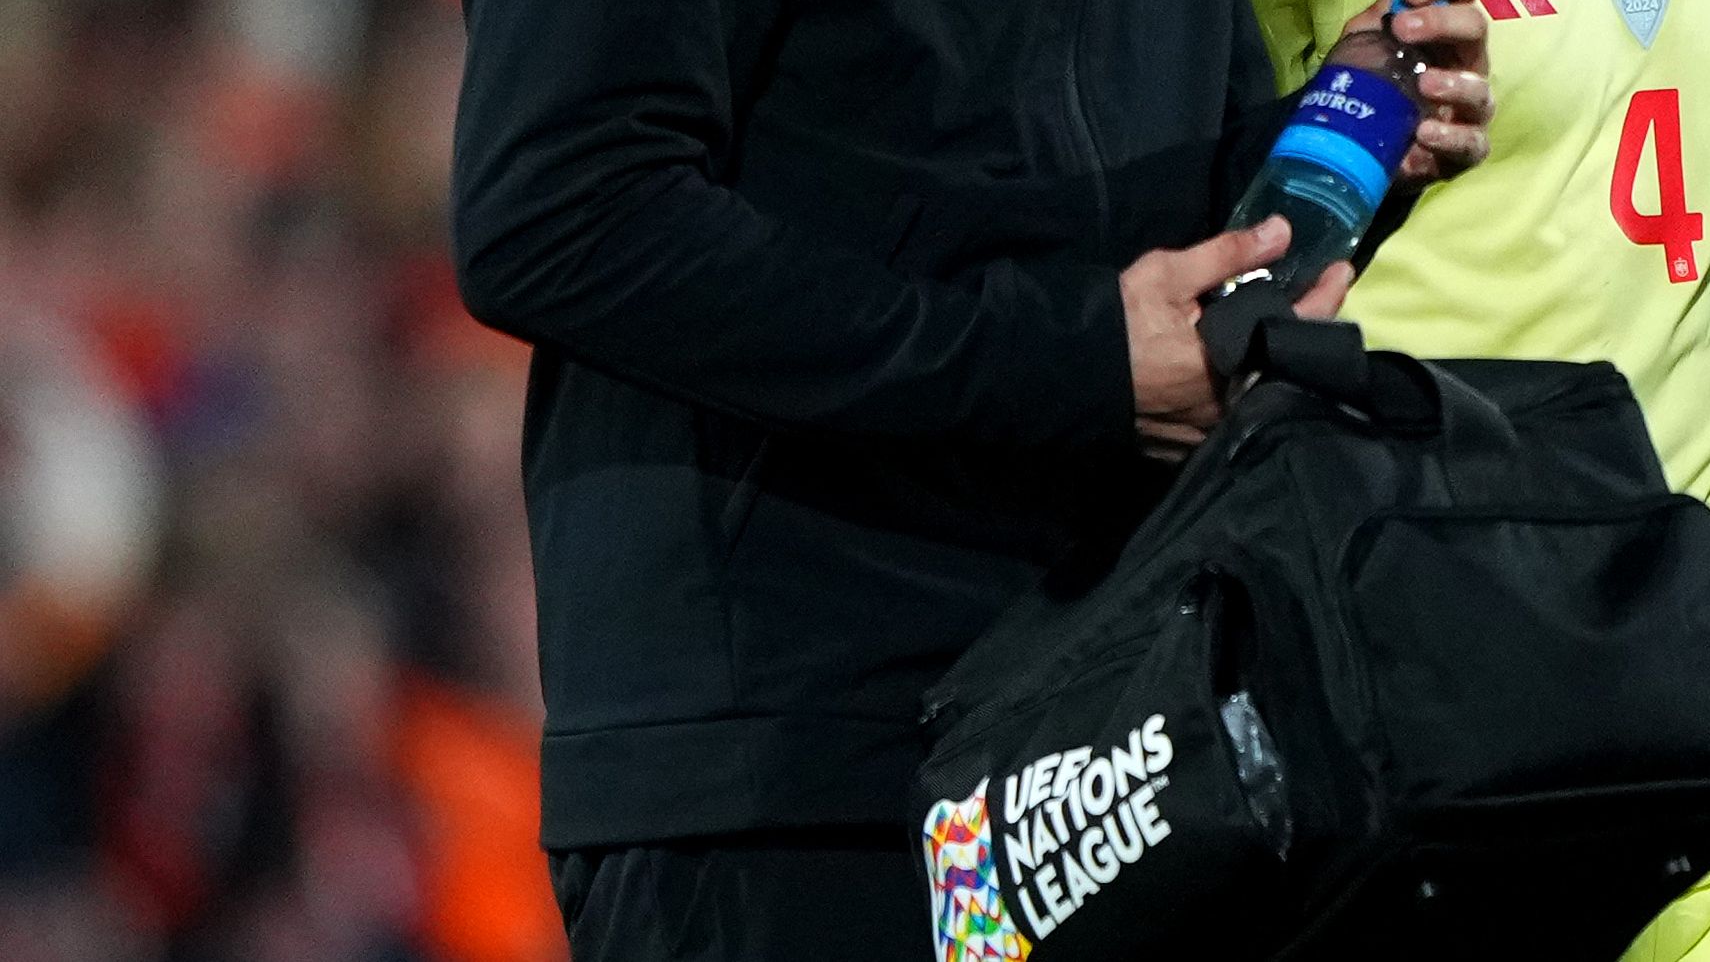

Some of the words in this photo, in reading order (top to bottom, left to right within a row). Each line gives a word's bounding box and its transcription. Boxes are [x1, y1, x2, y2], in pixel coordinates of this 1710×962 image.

[1299, 89, 1376, 119] OURCY
[1610, 88, 1703, 284] 4
[1004, 744, 1093, 824] UEFA
[1004, 713, 1174, 886] NATIONS
[1017, 782, 1172, 941] LEAGUE
